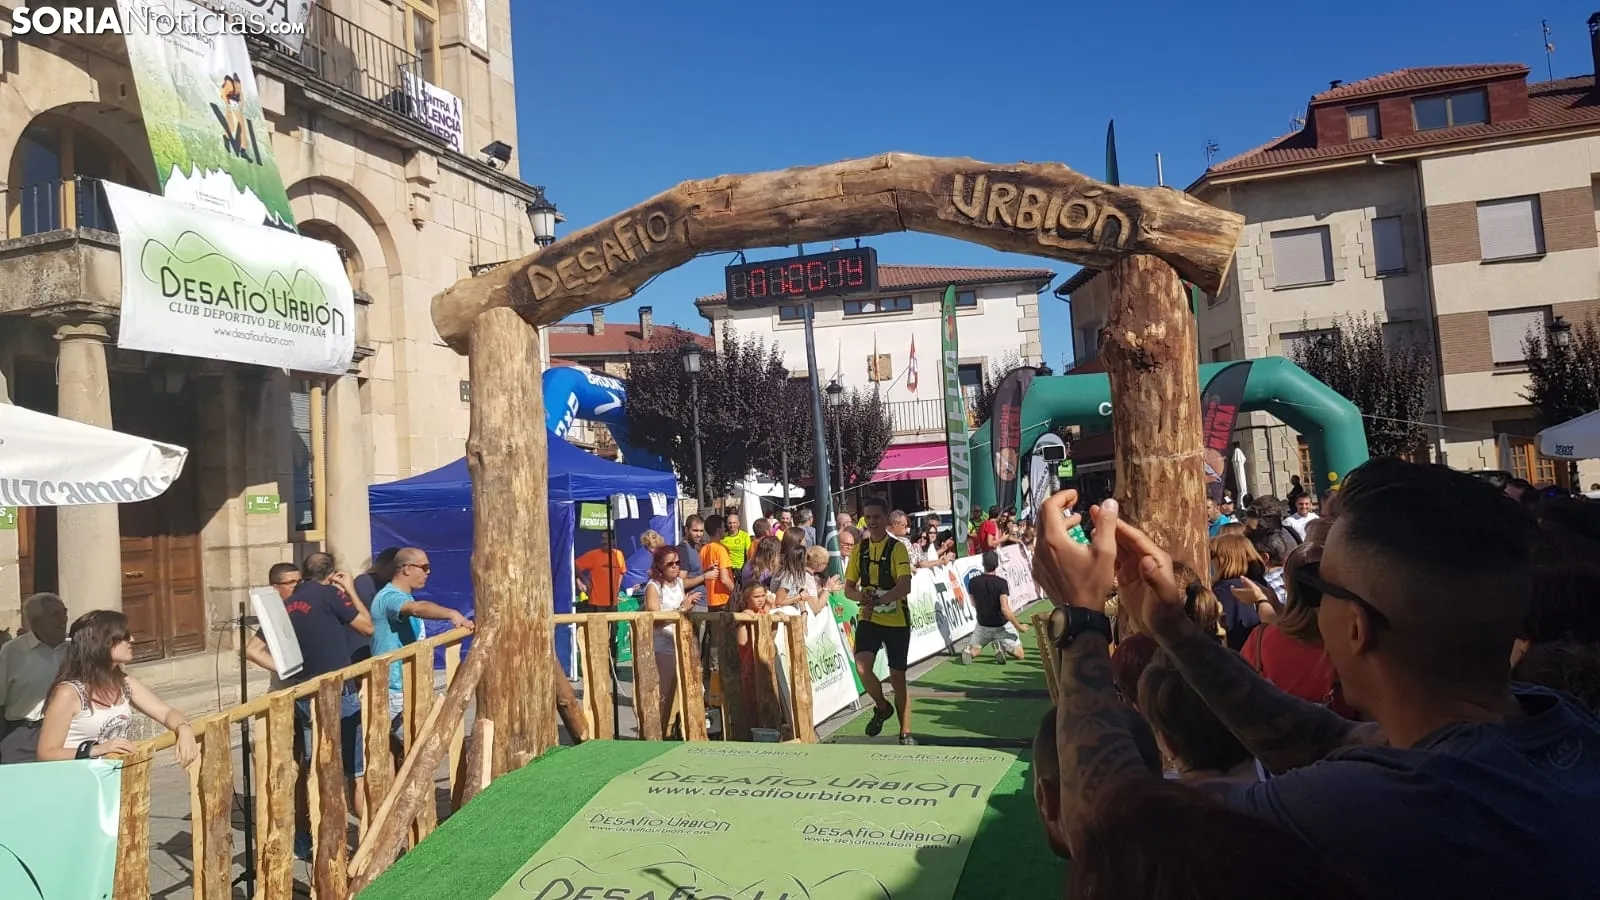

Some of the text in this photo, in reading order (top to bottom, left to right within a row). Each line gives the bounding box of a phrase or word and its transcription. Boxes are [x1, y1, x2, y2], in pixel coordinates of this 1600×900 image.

[168, 301, 328, 339] CLUB DEPORTIVO DE MONTAÑA
[647, 785, 938, 807] www.desafiourbion.com
